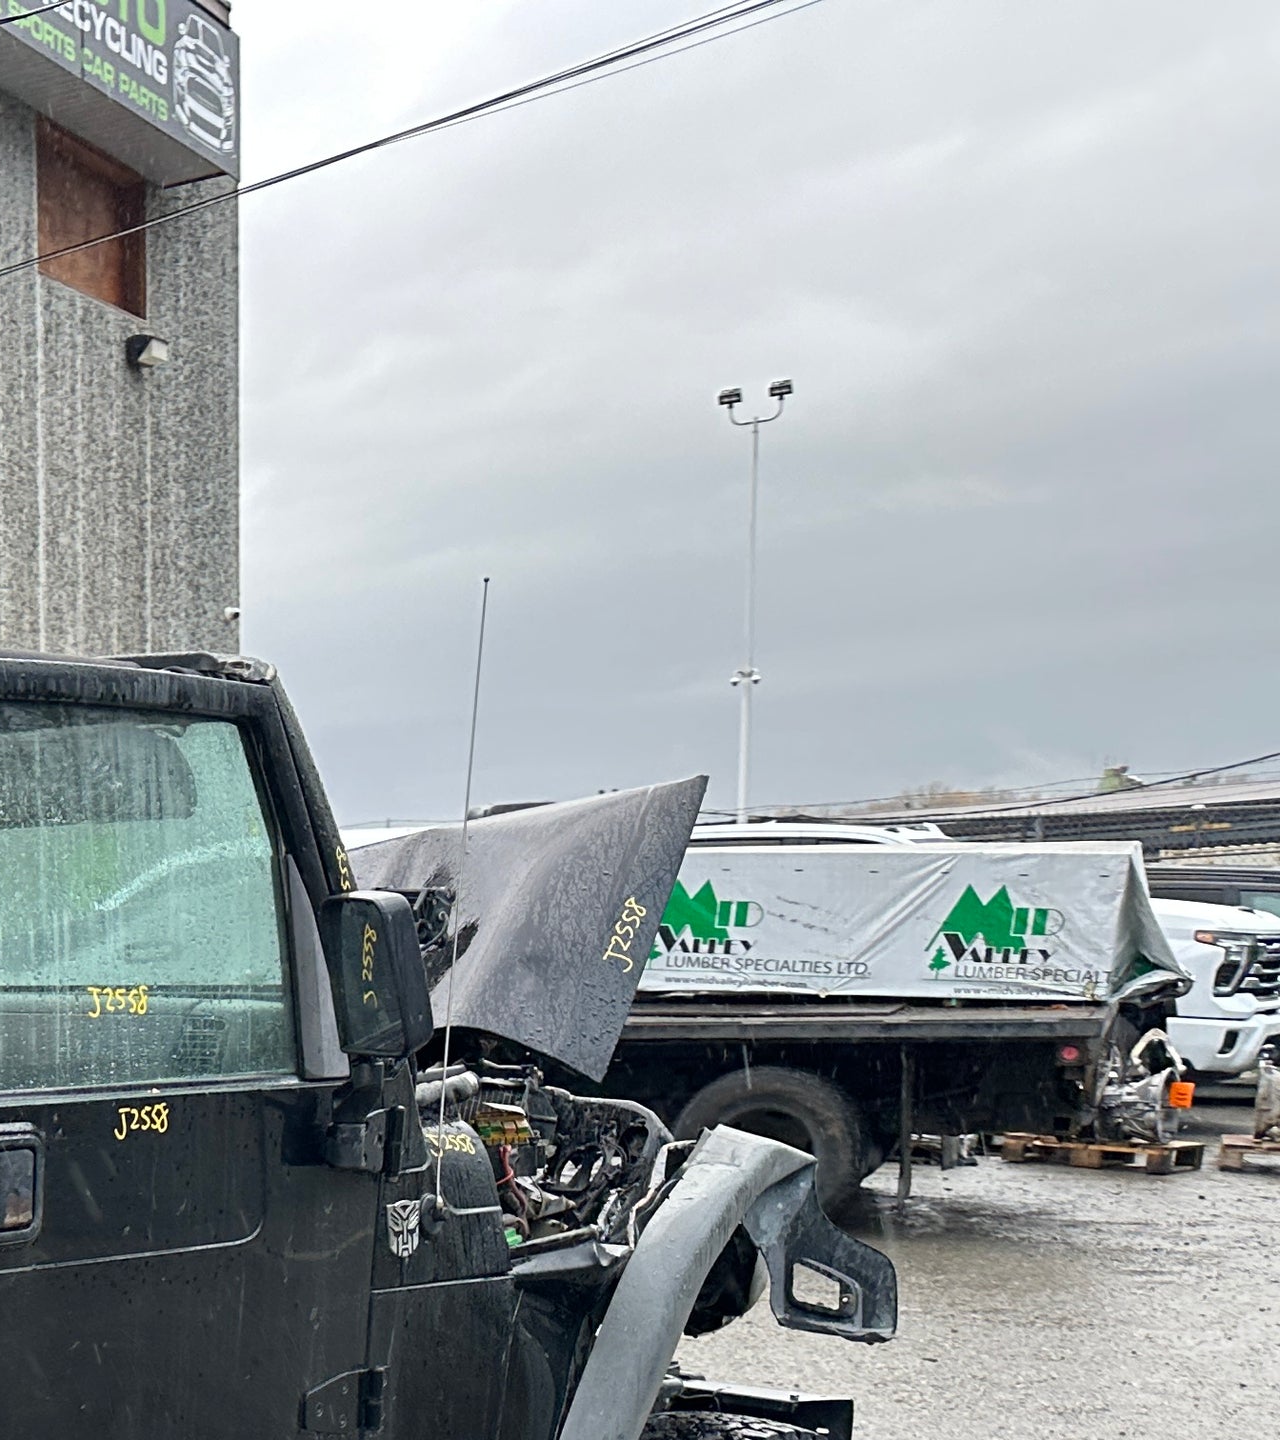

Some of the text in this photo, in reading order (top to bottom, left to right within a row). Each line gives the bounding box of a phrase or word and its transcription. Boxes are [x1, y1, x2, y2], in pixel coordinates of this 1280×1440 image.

[82, 47, 116, 89] CAR
[118, 72, 169, 122] PARTS
[603, 896, 647, 974] J2558
[659, 924, 757, 954] VALLEY
[943, 932, 1056, 964] VALLEY
[666, 955, 872, 976] LUMBER SPECIALTIES LTD.
[954, 965, 1026, 980] LUMBER
[87, 984, 149, 1018] J2558
[114, 1102, 170, 1140] J2558
